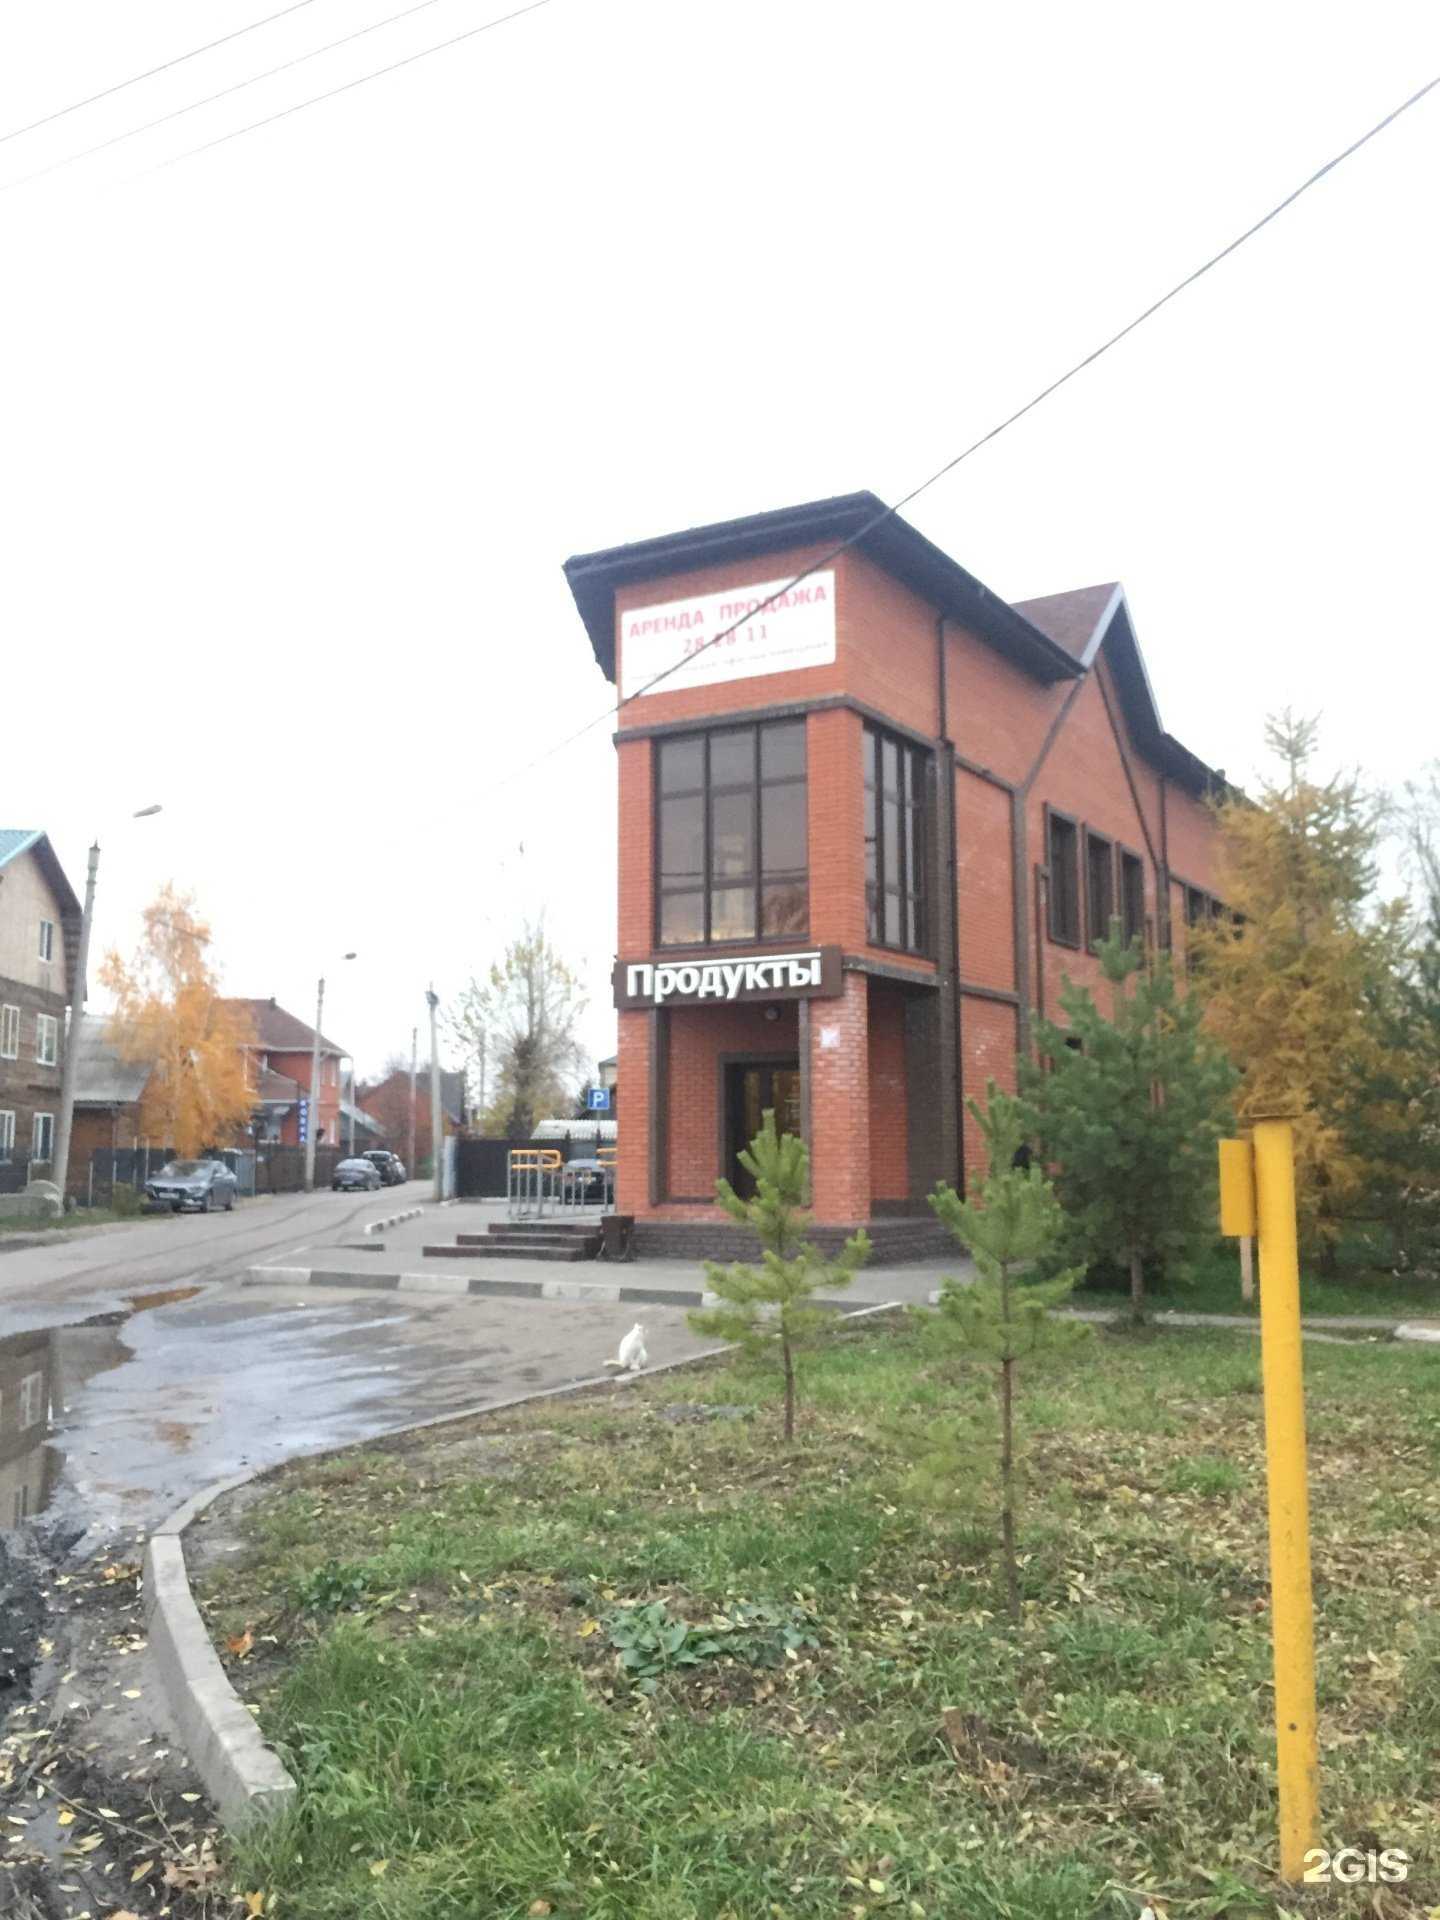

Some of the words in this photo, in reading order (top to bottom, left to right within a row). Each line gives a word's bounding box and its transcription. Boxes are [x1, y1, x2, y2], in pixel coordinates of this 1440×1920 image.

[629, 610, 704, 637] АРЕНДА
[720, 586, 826, 620] ПРОДАЖА
[627, 952, 821, 1003] Продукты
[593, 1091, 604, 1108] P
